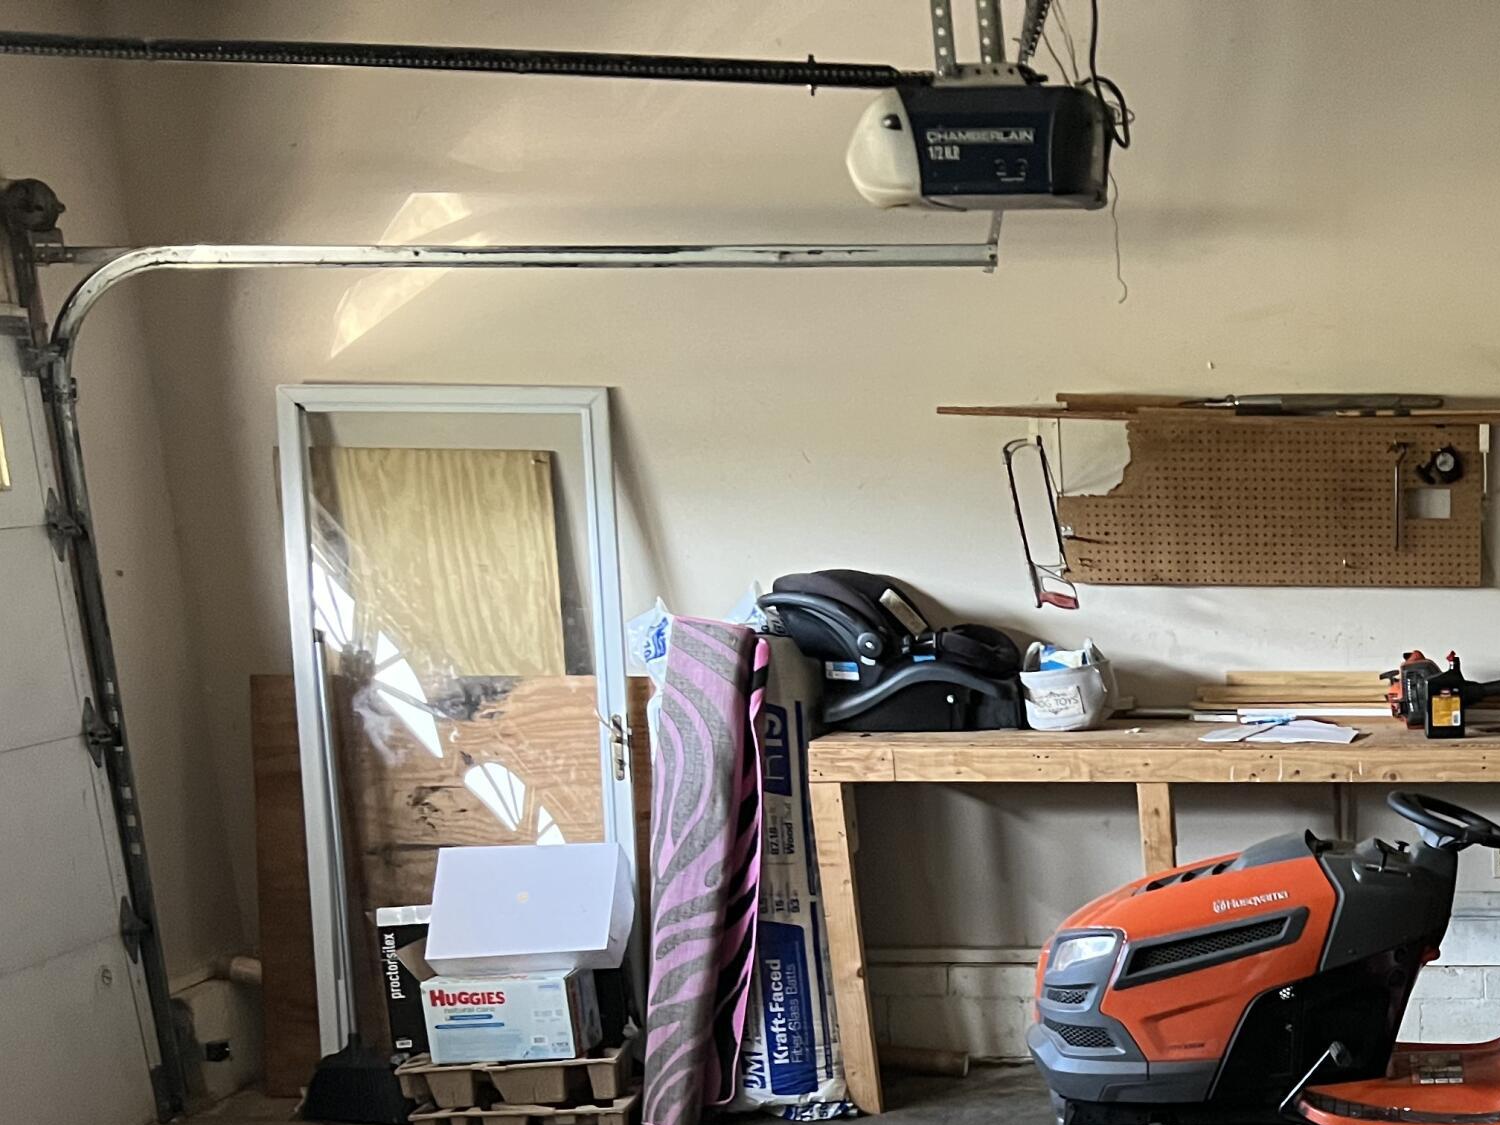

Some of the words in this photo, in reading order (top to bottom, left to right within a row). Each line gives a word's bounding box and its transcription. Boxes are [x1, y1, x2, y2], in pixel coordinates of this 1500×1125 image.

[926, 129, 1034, 143] CHAMBERLAIN
[429, 989, 505, 1007] HUGGIES
[765, 959, 790, 1064] Kraft-Faced
[788, 998, 801, 1031] Glass
